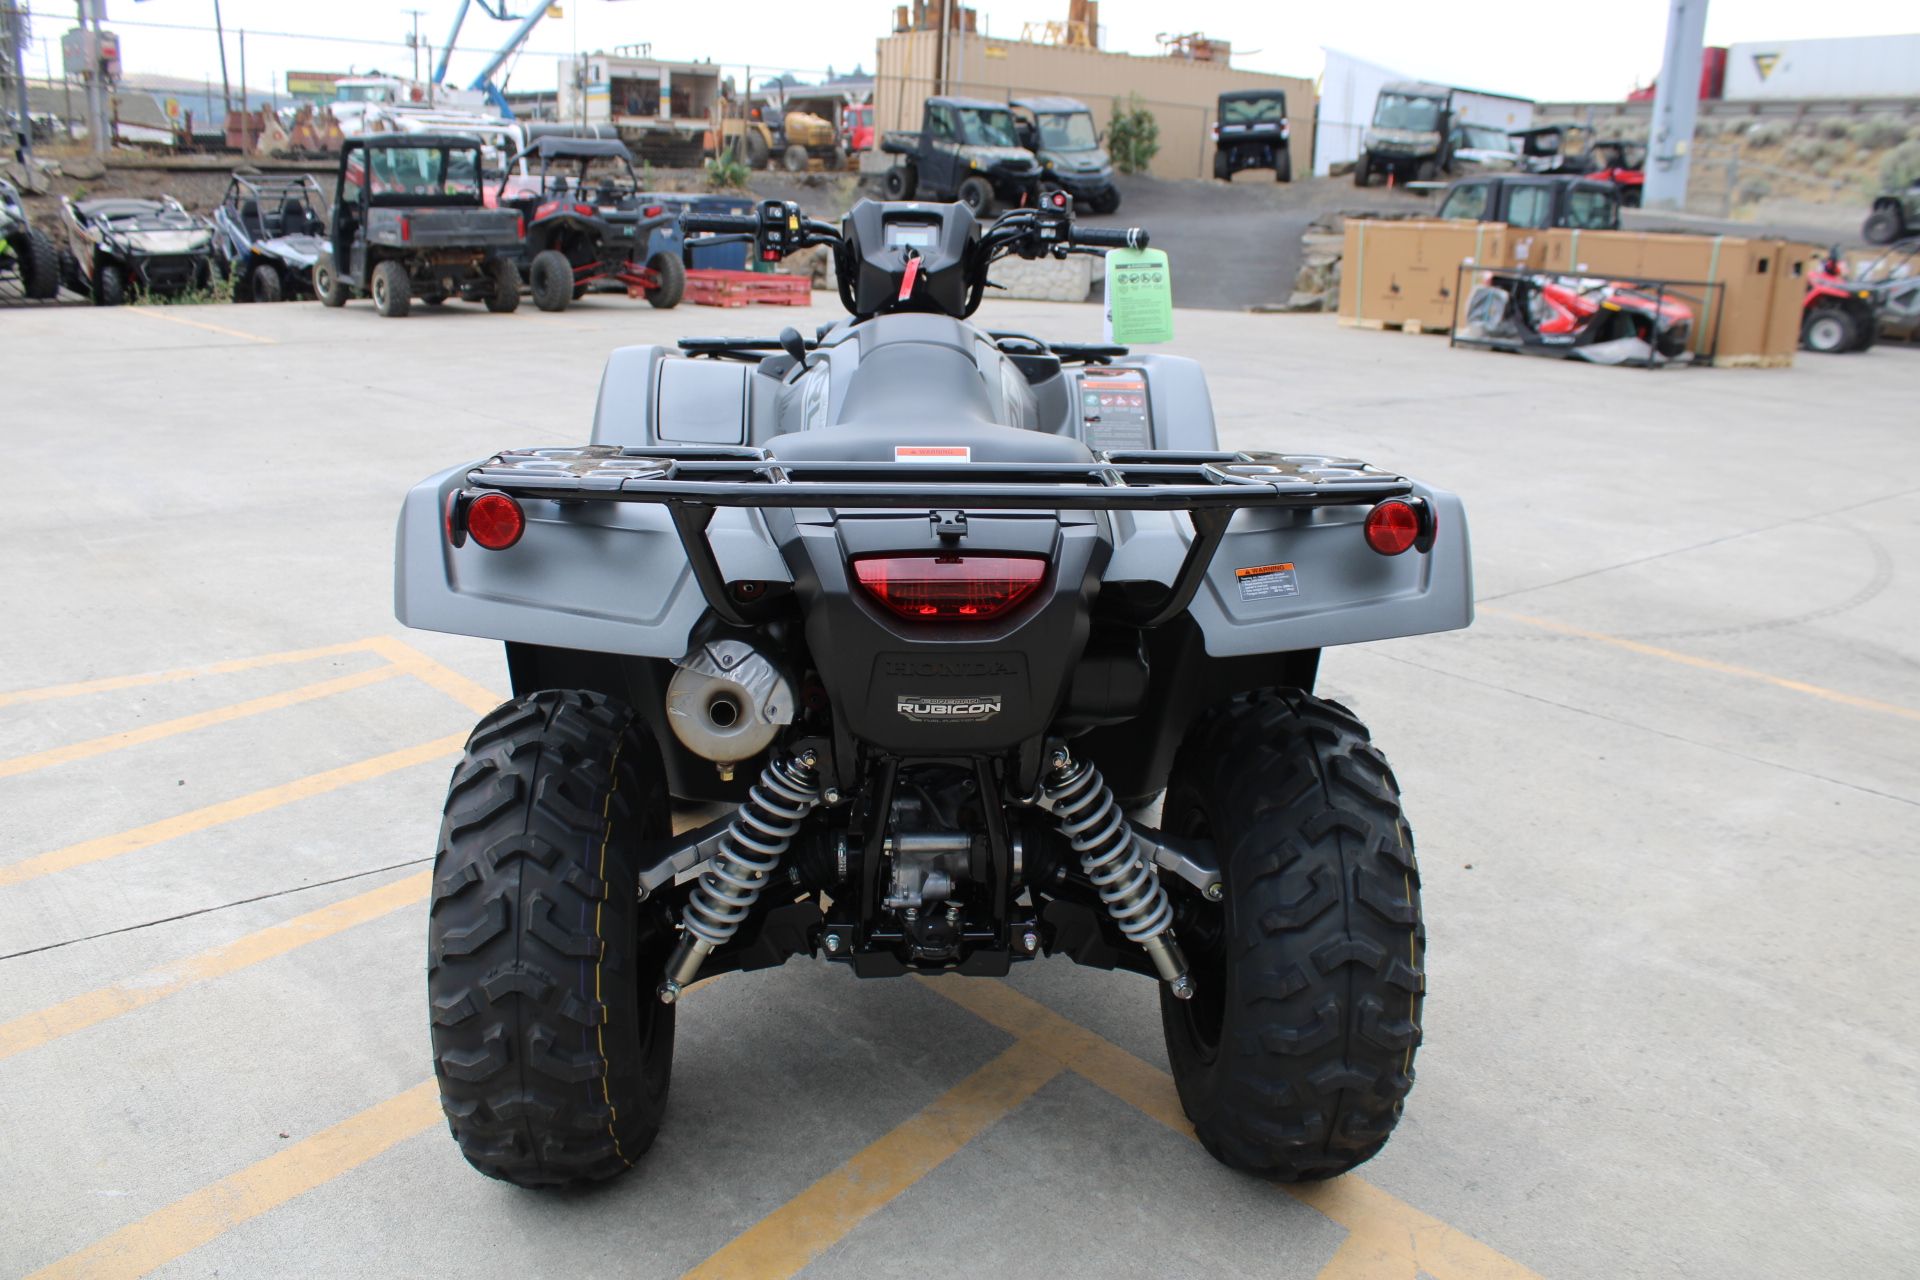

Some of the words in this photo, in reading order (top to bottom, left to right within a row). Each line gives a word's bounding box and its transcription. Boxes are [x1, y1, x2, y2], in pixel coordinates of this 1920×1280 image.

[1253, 565, 1285, 573] WARNING
[886, 662, 1019, 677] HONDA
[897, 703, 1001, 714] RUBICON
